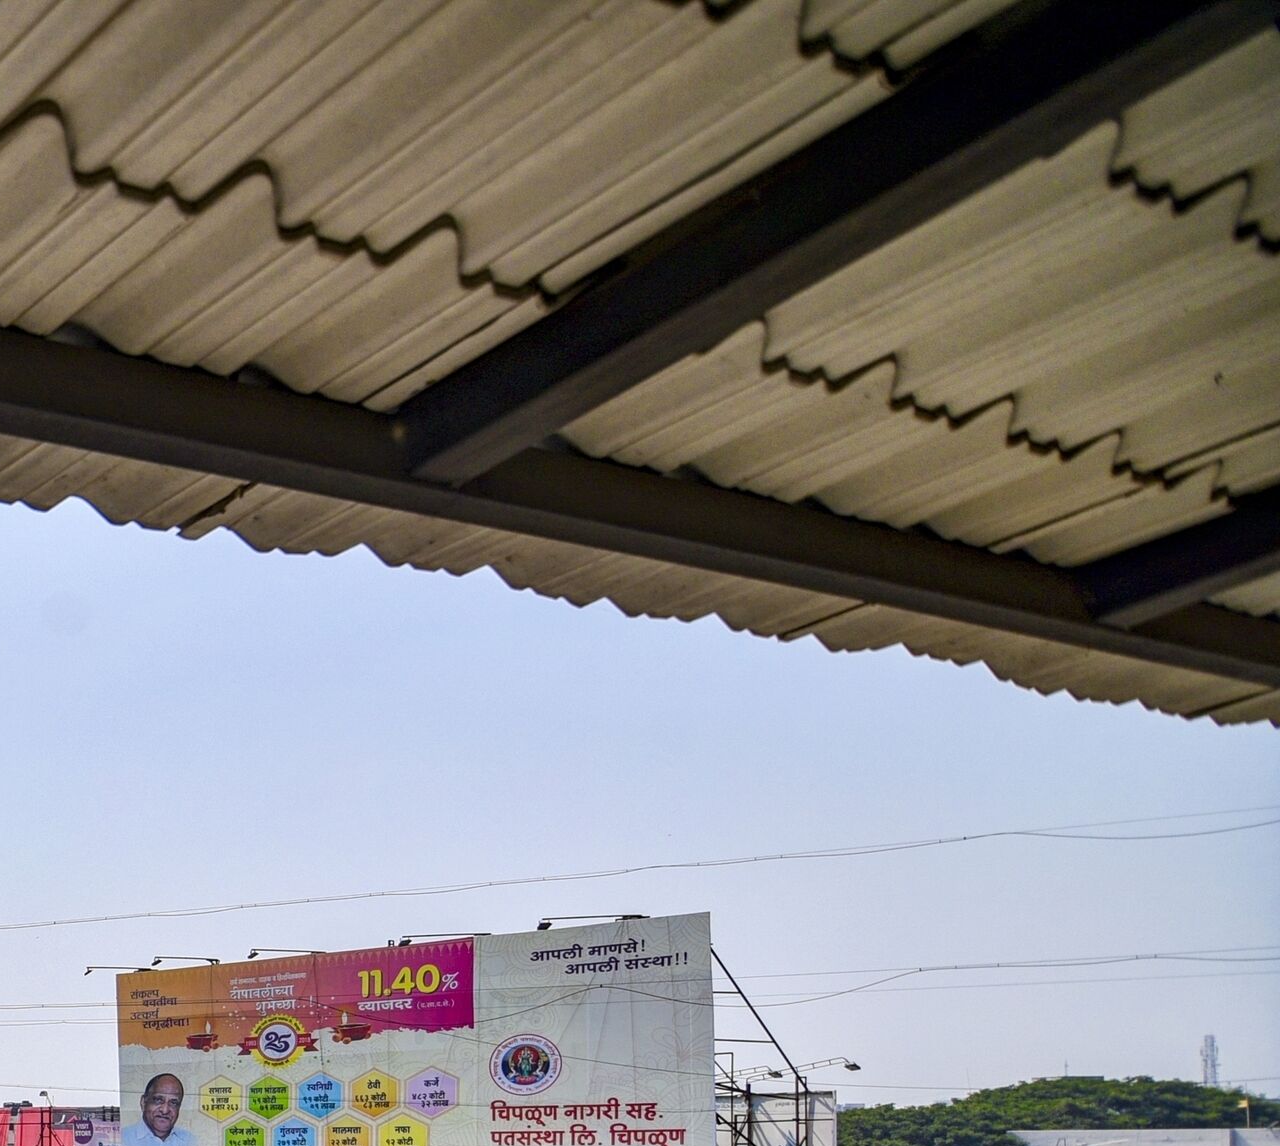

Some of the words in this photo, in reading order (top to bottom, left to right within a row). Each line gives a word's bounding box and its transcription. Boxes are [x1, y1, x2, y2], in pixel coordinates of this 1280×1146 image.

[529, 943, 583, 962] आपली
[587, 937, 646, 957] माणसे!
[564, 957, 620, 975] आपली
[624, 951, 689, 970] संस्था!!
[229, 983, 295, 1000] दीपावलीच्या
[358, 962, 459, 999] 11.40%
[358, 997, 413, 1012] व्याजदर
[264, 1031, 292, 1053] 25
[370, 1092, 387, 1101] कोटी
[429, 1090, 446, 1100] कोटी
[490, 1099, 559, 1127] चिपळूण
[563, 1097, 621, 1121] नागरी
[625, 1102, 664, 1122] सह.
[490, 1124, 565, 1146] पतसंस्था
[569, 1123, 603, 1146] लि.
